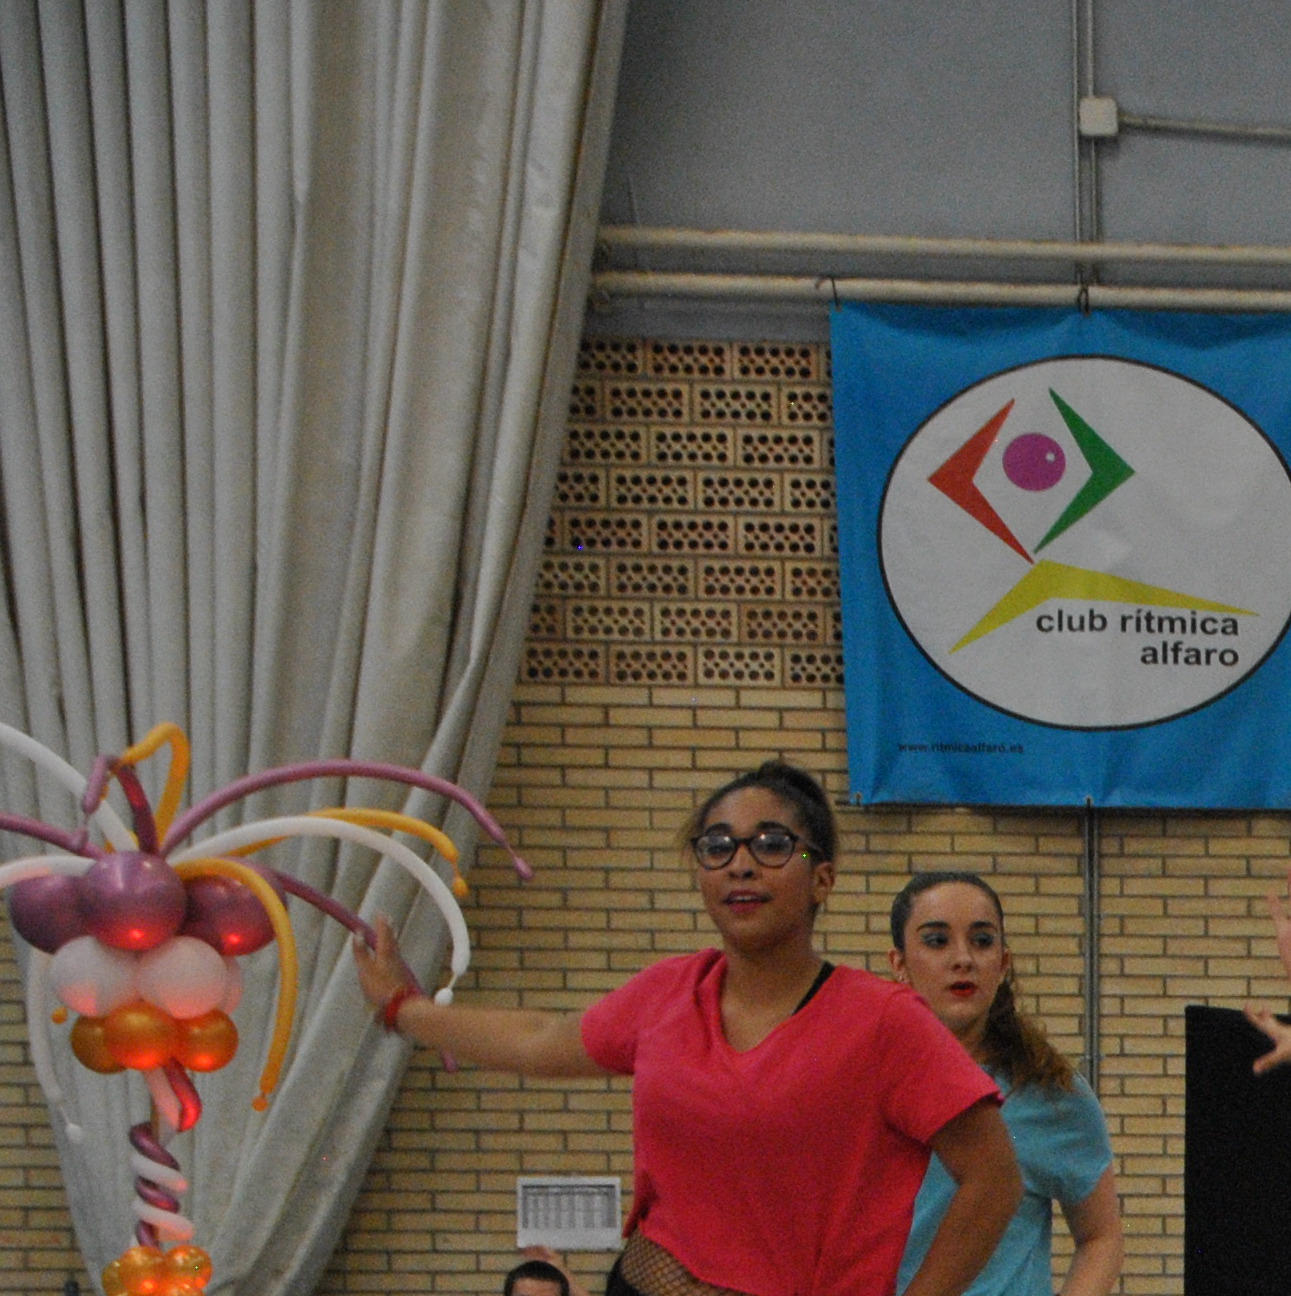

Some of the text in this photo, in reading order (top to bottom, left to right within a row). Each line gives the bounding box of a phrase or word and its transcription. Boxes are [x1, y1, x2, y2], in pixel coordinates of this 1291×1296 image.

[1035, 608, 1240, 636] club rítmica
[1140, 640, 1240, 667] alfaro
